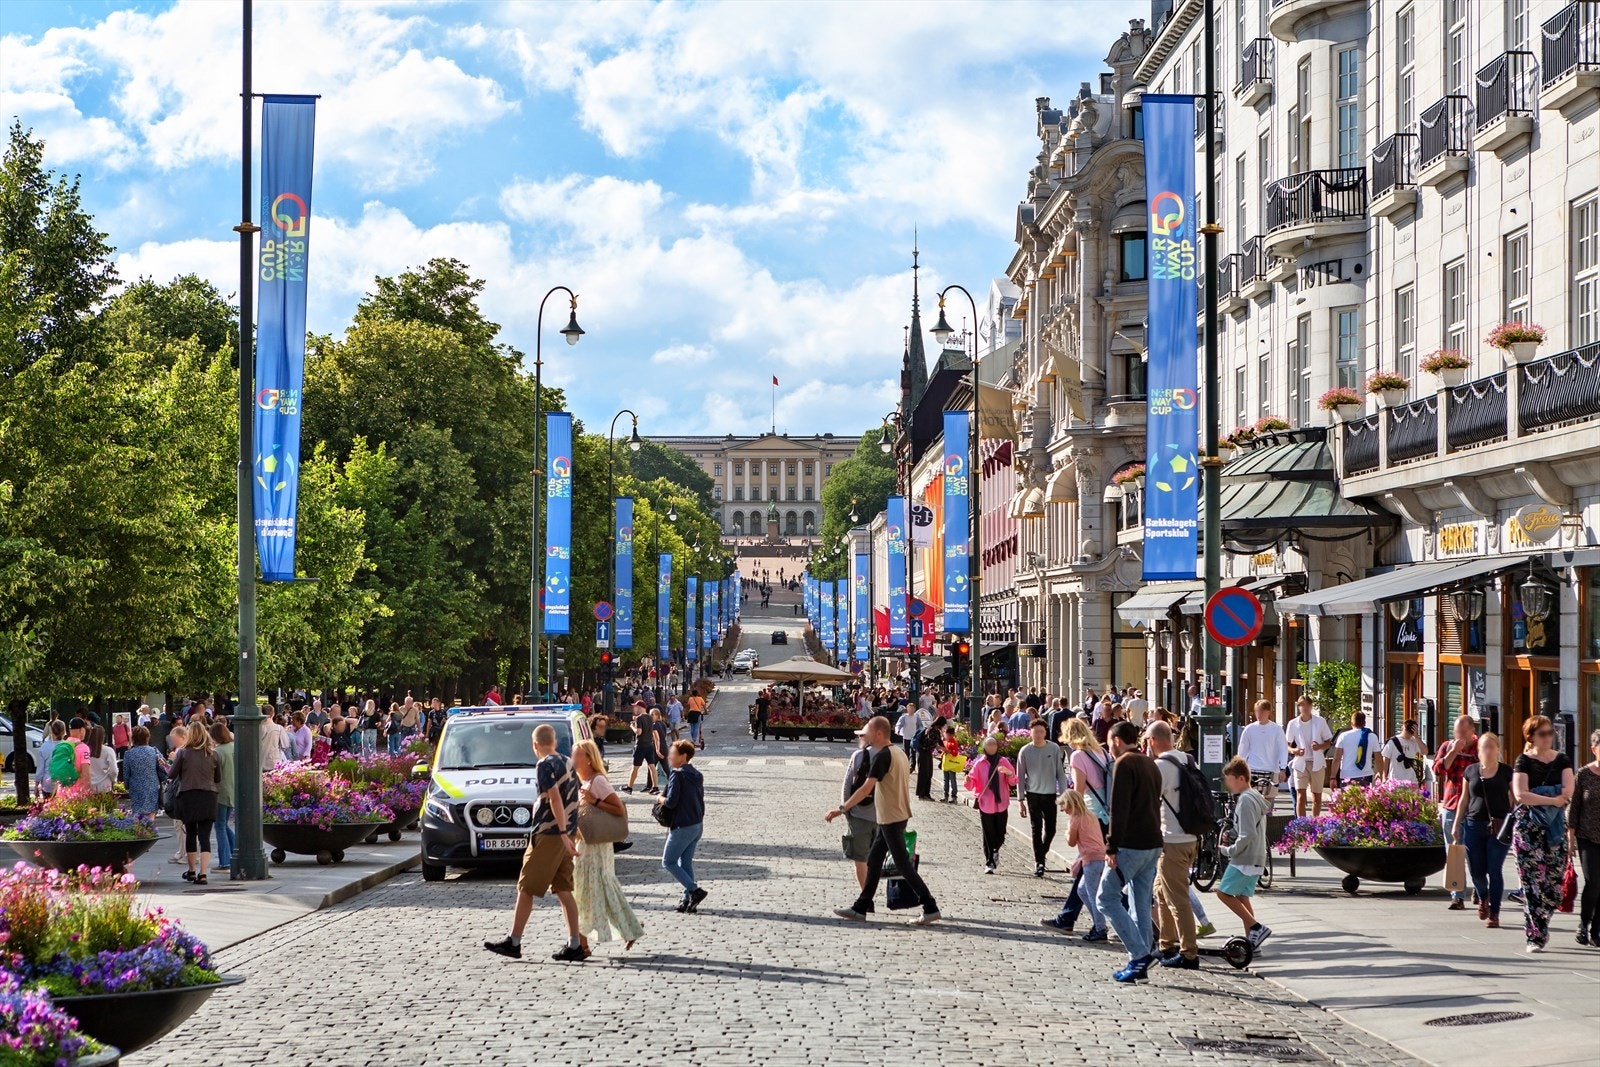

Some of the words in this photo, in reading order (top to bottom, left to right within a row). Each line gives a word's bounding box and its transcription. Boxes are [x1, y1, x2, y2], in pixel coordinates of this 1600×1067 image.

[1167, 239, 1181, 280] WAY
[1181, 239, 1195, 280] CUP
[1300, 258, 1352, 291] HOTEL
[1151, 398, 1172, 406] WAY
[1150, 406, 1172, 415] CUP
[1145, 517, 1197, 529] Bækkelagets
[1524, 507, 1560, 532] Freia
[1145, 528, 1189, 539] Sportsklub
[485, 840, 497, 848] DR
[500, 839, 527, 848] 85499
